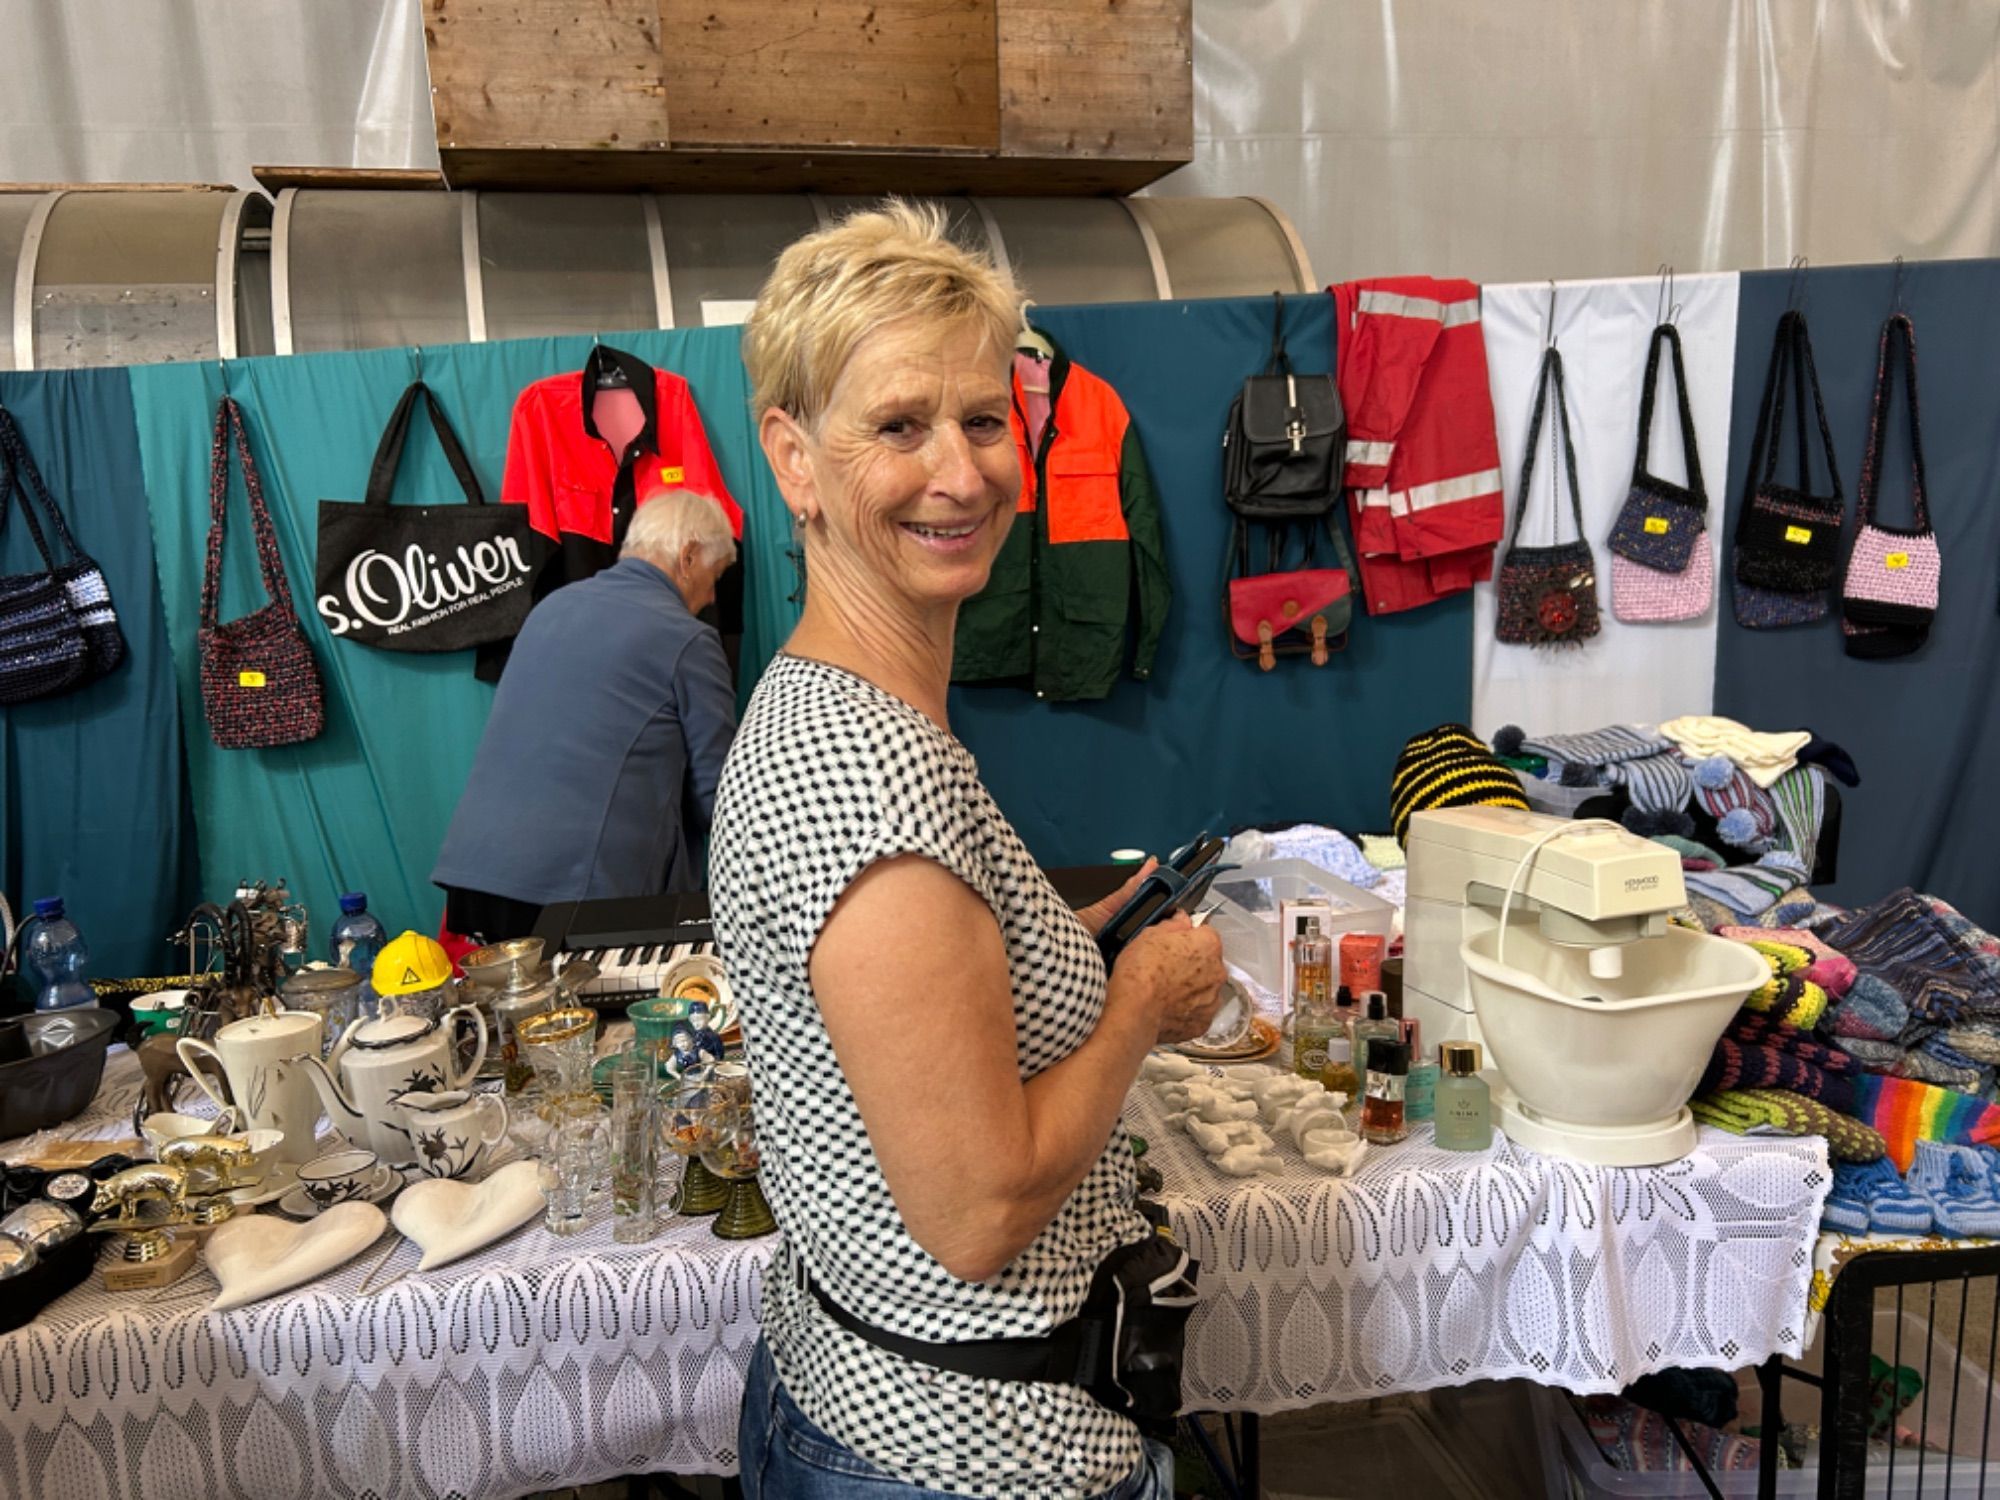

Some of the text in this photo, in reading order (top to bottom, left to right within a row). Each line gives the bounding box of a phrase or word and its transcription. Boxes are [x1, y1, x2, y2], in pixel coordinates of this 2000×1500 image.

[317, 535, 531, 636] s.Oliver
[387, 576, 524, 635] REAL FASHION FOR REAL PEOPLE
